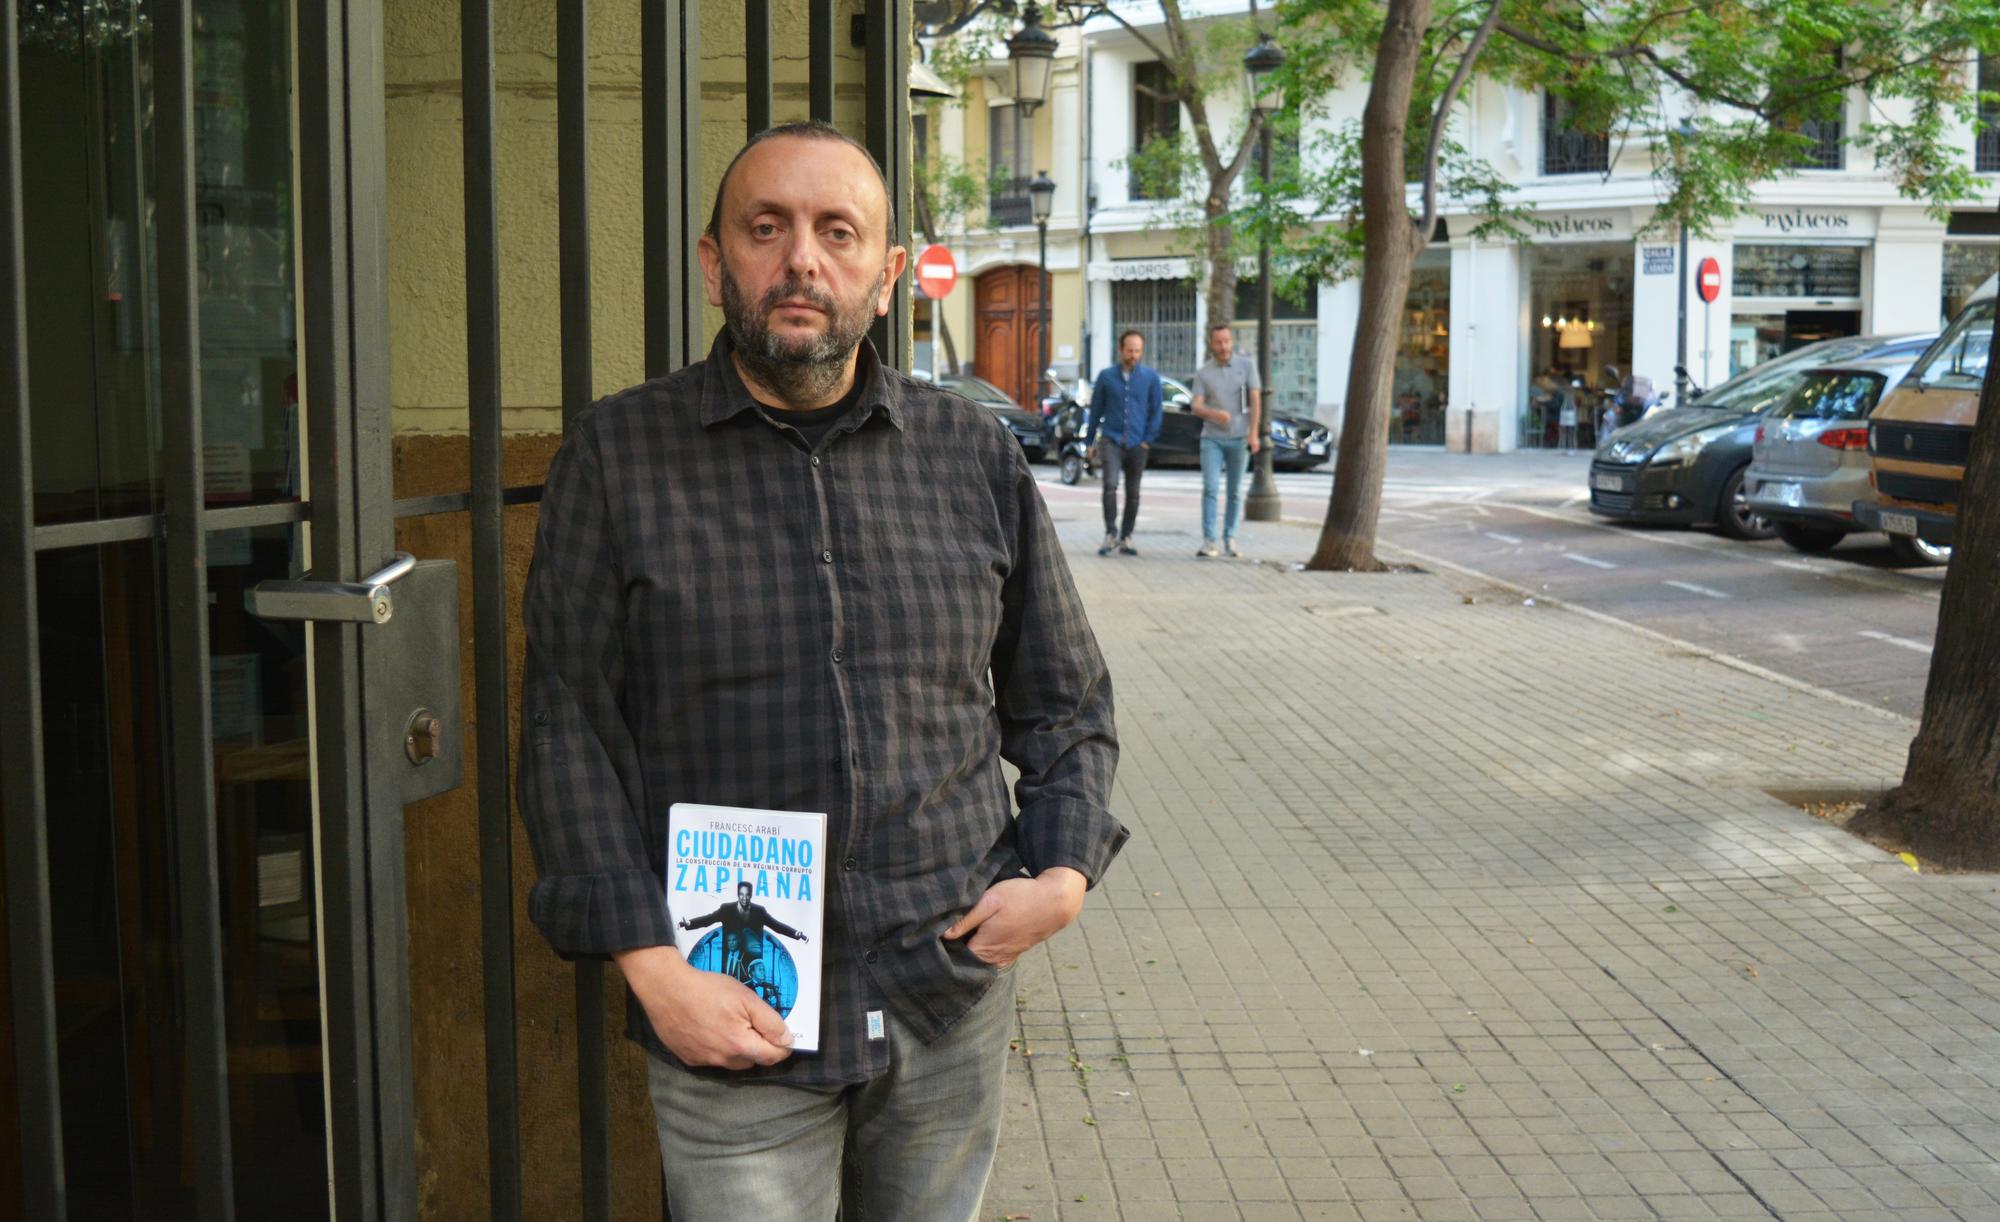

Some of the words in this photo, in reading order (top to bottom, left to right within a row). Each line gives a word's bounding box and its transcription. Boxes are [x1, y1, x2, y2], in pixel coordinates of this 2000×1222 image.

[1112, 263, 1171, 277] CUADROS
[709, 821, 753, 834] FRANCESC
[676, 829, 813, 868] CIUDADANO
[782, 865, 813, 875] CORRUPTO
